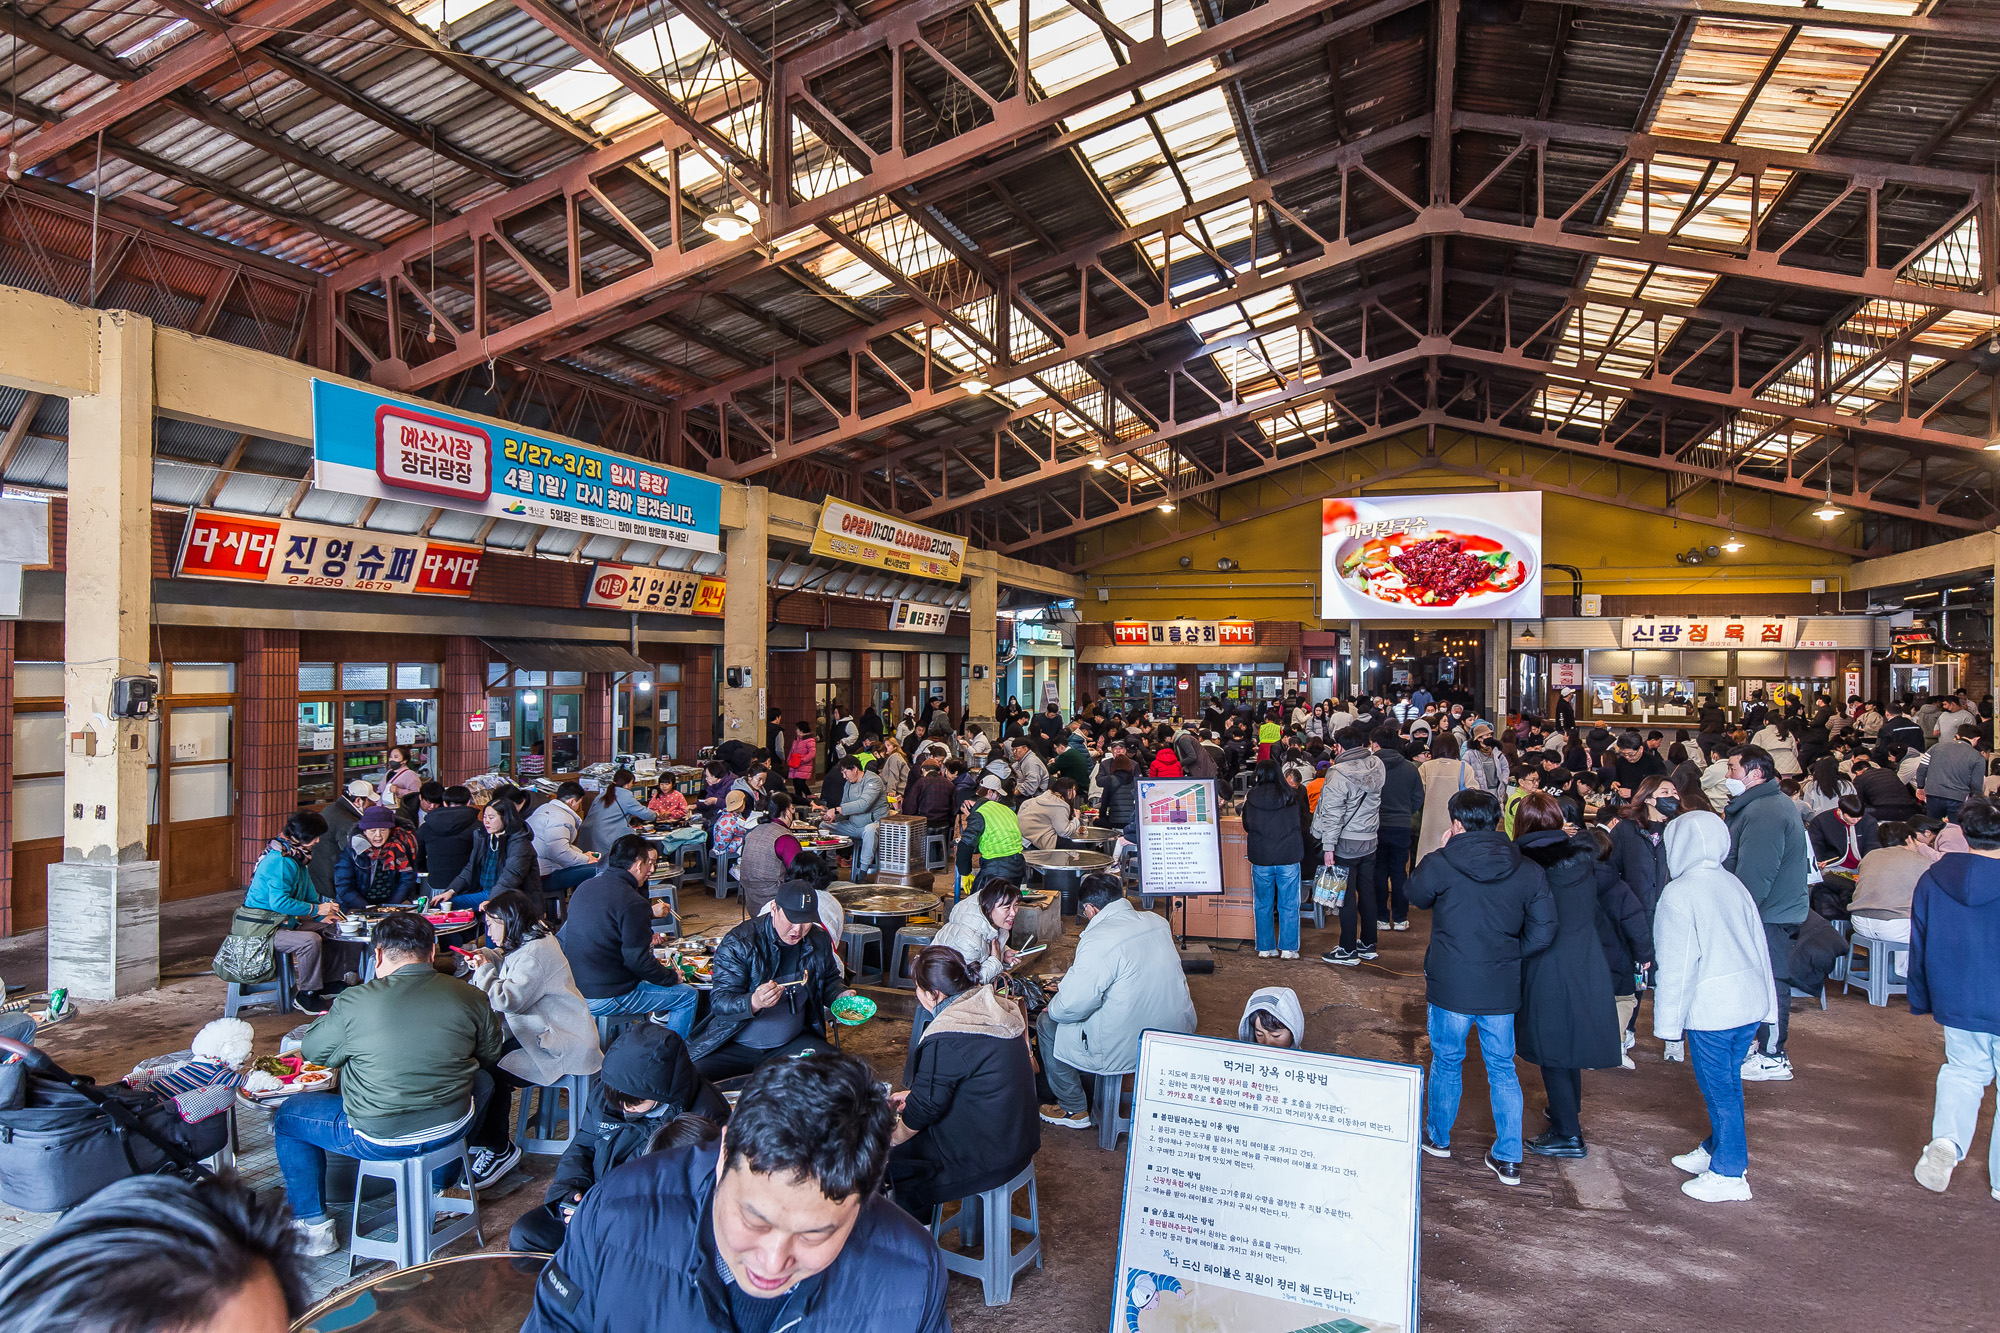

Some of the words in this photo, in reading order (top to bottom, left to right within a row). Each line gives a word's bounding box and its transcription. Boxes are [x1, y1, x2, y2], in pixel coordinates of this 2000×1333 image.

[400, 425, 473, 460] 예산시장
[400, 450, 473, 485] 장터광장
[503, 438, 603, 480] 2/27~3/31
[610, 463, 637, 490] 임시
[638, 470, 670, 497] 휴장!
[503, 467, 534, 493] 4월
[537, 473, 568, 500] 1일!
[575, 482, 604, 508] 다시
[607, 488, 634, 514] 찾아
[636, 495, 696, 527] 뵙겠습니다.
[550, 508, 578, 524] 5일장은
[580, 514, 616, 531] 변동없으니
[618, 520, 632, 533] 많이
[634, 524, 647, 536] 많이
[648, 526, 668, 540] 방문해
[668, 530, 689, 544] 주세요!
[842, 512, 874, 538] OPEN
[872, 522, 896, 542] 11:00
[894, 528, 931, 552] CLOSED
[930, 538, 952, 556] 21:00
[1344, 516, 1428, 540] 마라칼국수
[192, 527, 276, 568] 다시다
[282, 534, 418, 583] 진영슈퍼
[424, 554, 480, 586] 다시다
[355, 579, 392, 591] 4679
[599, 577, 624, 596] 미원
[627, 576, 699, 608] 진영상회
[1116, 626, 1148, 640] 다시다
[1152, 626, 1216, 642] 대흥상회
[1219, 626, 1254, 641] 다시다
[1168, 1069, 1189, 1078] 지도에
[1190, 1072, 1210, 1082] 표기된
[1212, 1076, 1226, 1085] 매장
[1228, 1078, 1249, 1088] 위치를
[1223, 1060, 1255, 1074] 먹거리
[1259, 1065, 1280, 1078] 장옥
[1284, 1070, 1328, 1085] 이용방법
[1168, 1079, 1188, 1089] 원하는
[1190, 1083, 1211, 1092] 매장에
[1242, 1091, 1263, 1101] 메뉴를
[1265, 1094, 1279, 1103] 주문
[1238, 1101, 1259, 1111] 메뉴를
[1261, 1105, 1283, 1114] 가지고
[1278, 1146, 1298, 1155] 가지고
[1155, 1165, 1170, 1174] 고기
[1171, 1167, 1185, 1177] 먹는
[1177, 1212, 1199, 1223] 마시는
[1181, 1259, 1201, 1272] 드신
[1203, 1264, 1241, 1280] 테이블은
[1245, 1272, 1274, 1286] 직원이
[1277, 1278, 1297, 1291] 정리
[1299, 1283, 1310, 1294] 해
